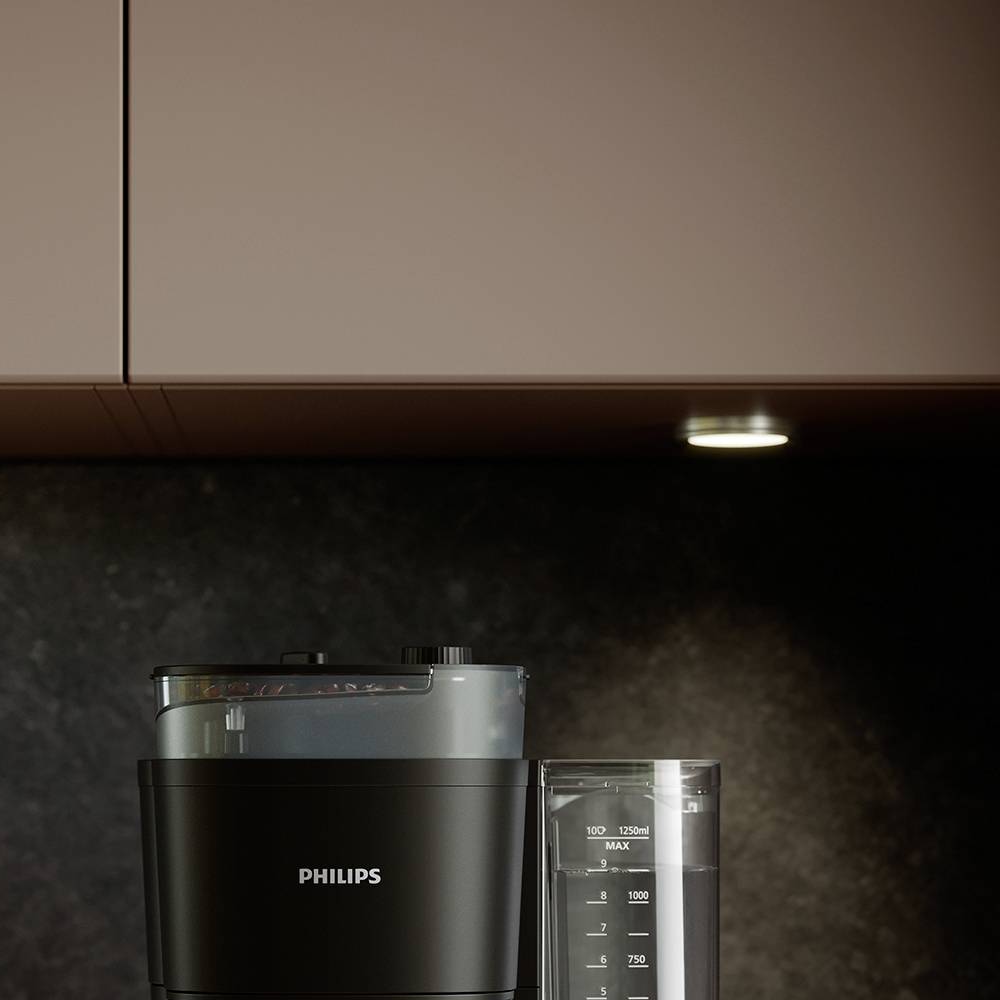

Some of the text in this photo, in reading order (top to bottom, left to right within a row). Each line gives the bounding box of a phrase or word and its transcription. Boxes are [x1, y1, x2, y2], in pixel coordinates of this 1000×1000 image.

[618, 825, 650, 835] 1250ml
[605, 841, 630, 851] MAX
[600, 859, 607, 868] 9
[299, 868, 382, 884] PHILIPS
[600, 891, 649, 900] 8 1000
[600, 923, 607, 932] 7
[600, 955, 646, 964] 6 750
[600, 987, 607, 996] 5
